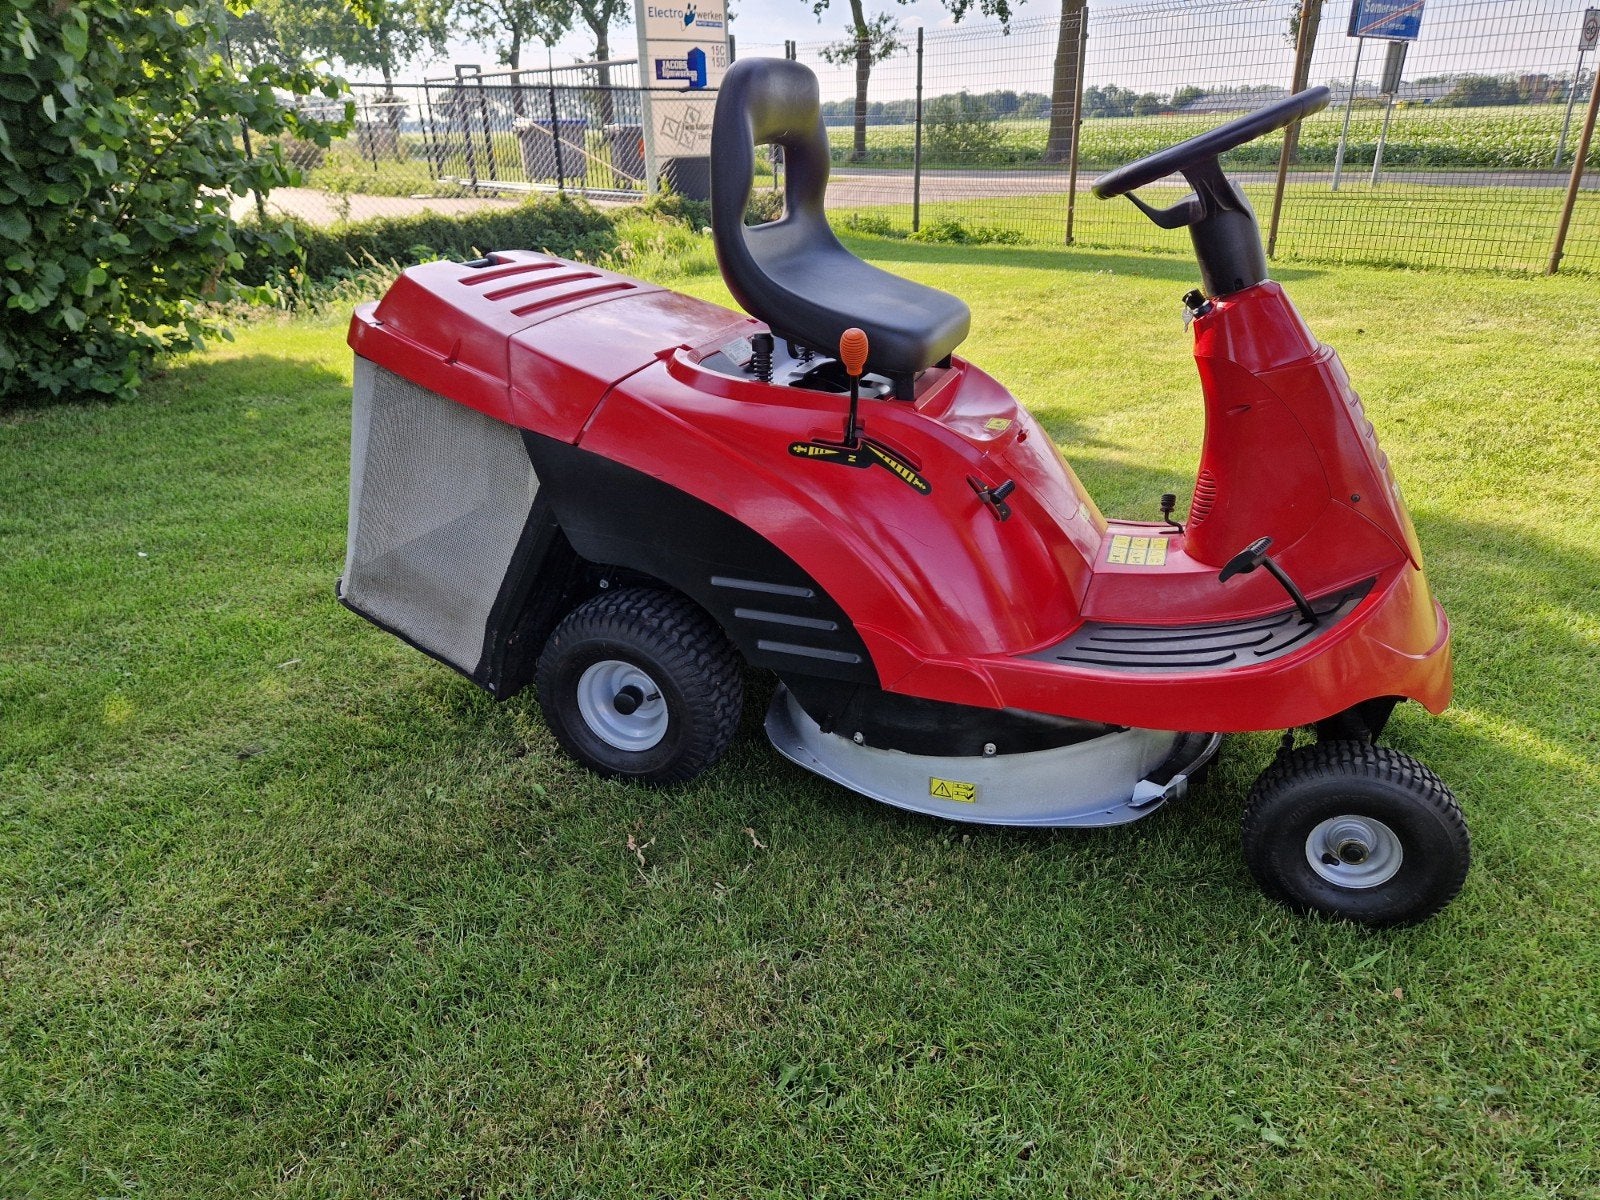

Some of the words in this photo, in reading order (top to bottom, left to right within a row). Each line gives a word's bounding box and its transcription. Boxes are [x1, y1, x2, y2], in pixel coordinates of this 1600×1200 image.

[648, 6, 683, 19] Electro
[697, 11, 722, 20] werken
[711, 46, 724, 55] 15C
[662, 60, 687, 69] JACOBS
[712, 57, 725, 67] 15D
